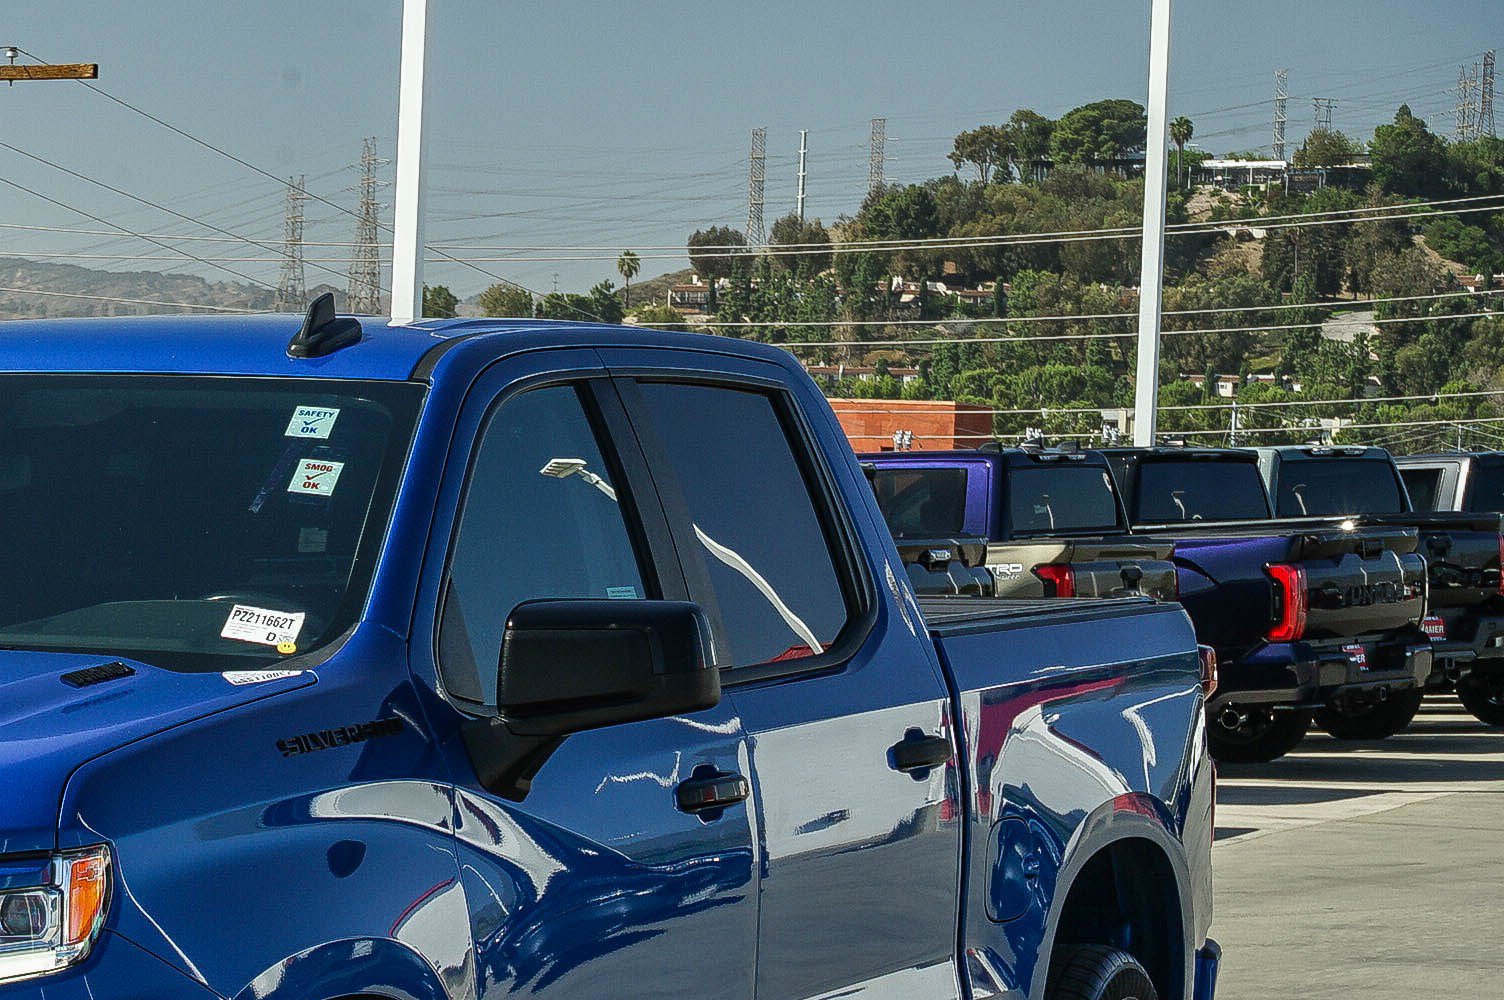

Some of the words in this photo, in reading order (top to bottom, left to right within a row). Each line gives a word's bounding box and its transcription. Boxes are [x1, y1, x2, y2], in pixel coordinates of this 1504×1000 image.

[298, 409, 336, 418] SAFETY
[300, 426, 318, 434] OK
[304, 463, 334, 472] SMOG
[302, 481, 320, 489] OK
[232, 609, 296, 630] PZ211662T
[276, 717, 403, 758] SILVER
